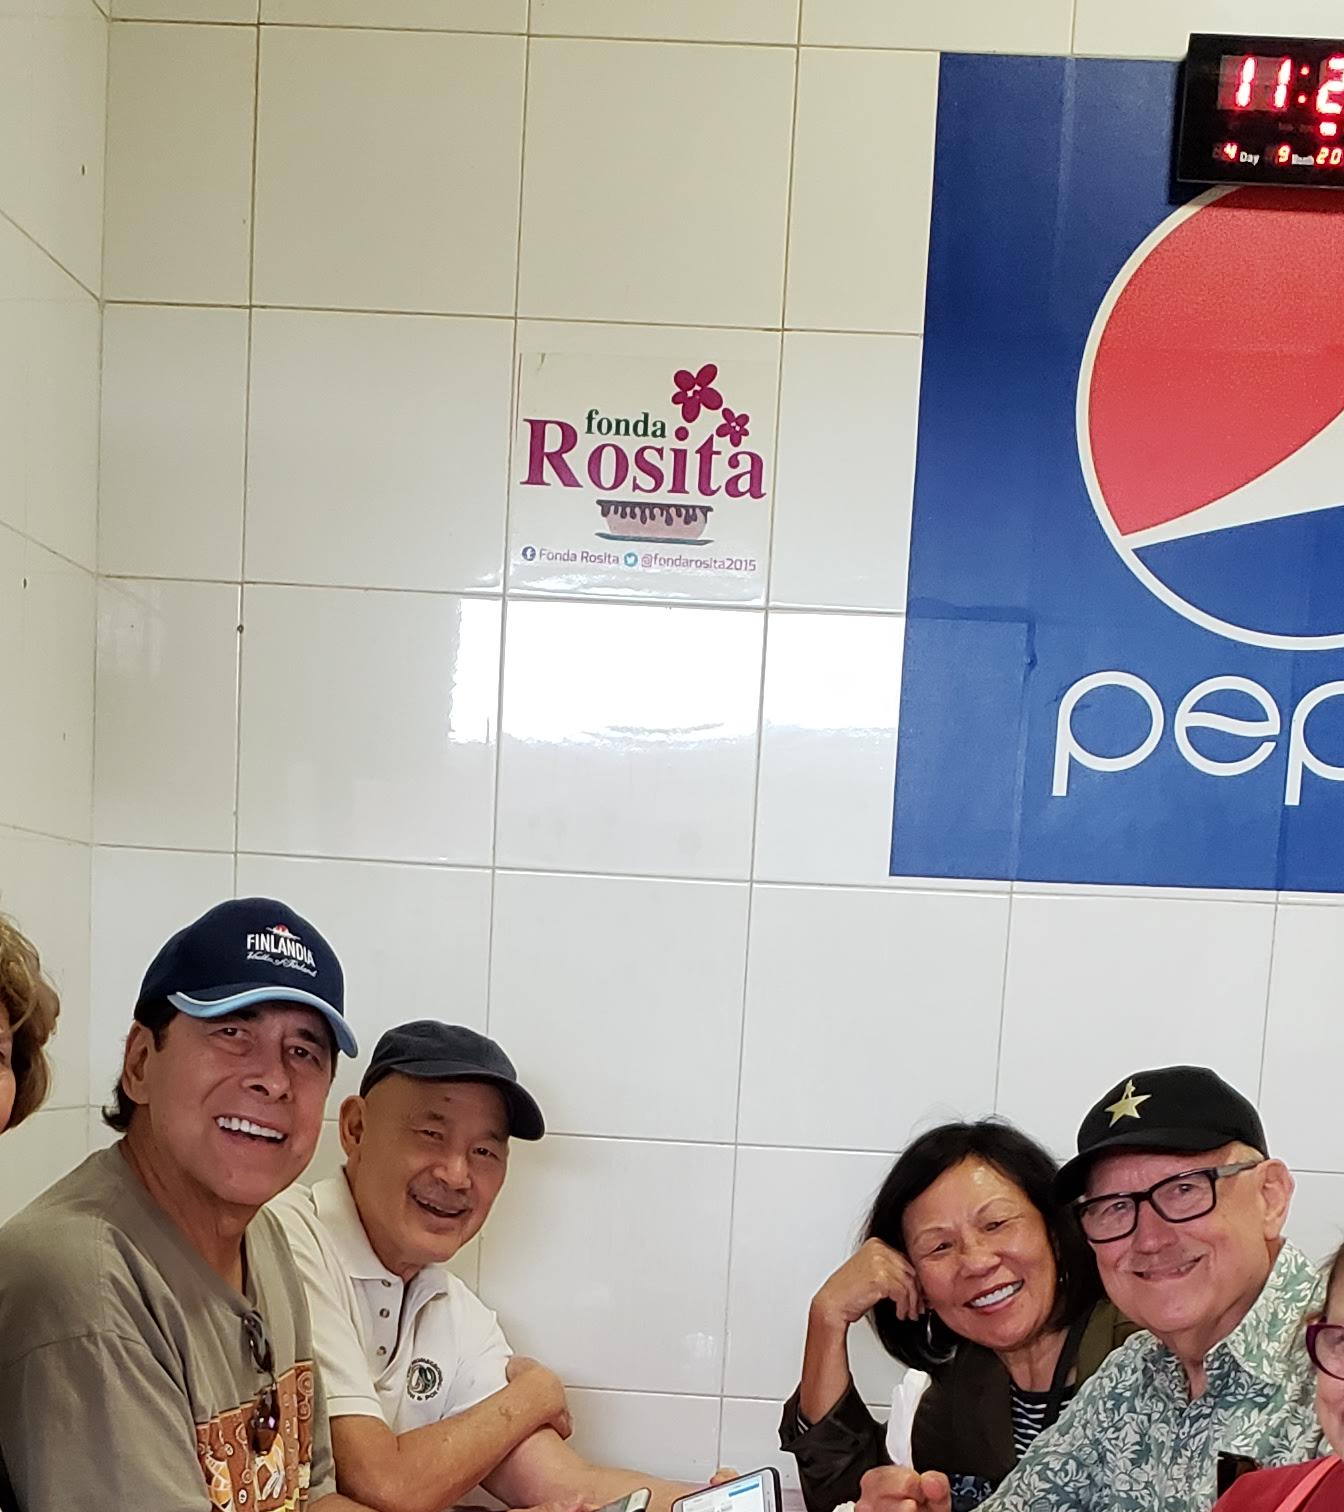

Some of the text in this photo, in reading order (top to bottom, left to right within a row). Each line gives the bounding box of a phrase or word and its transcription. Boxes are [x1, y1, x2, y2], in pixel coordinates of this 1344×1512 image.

[1240, 151, 1260, 166] Day
[585, 408, 667, 438] fonda
[520, 419, 767, 499] Rosita
[539, 548, 756, 572] Fonda Rosita @fondarosita2015
[246, 932, 316, 968] FINLANDIA
